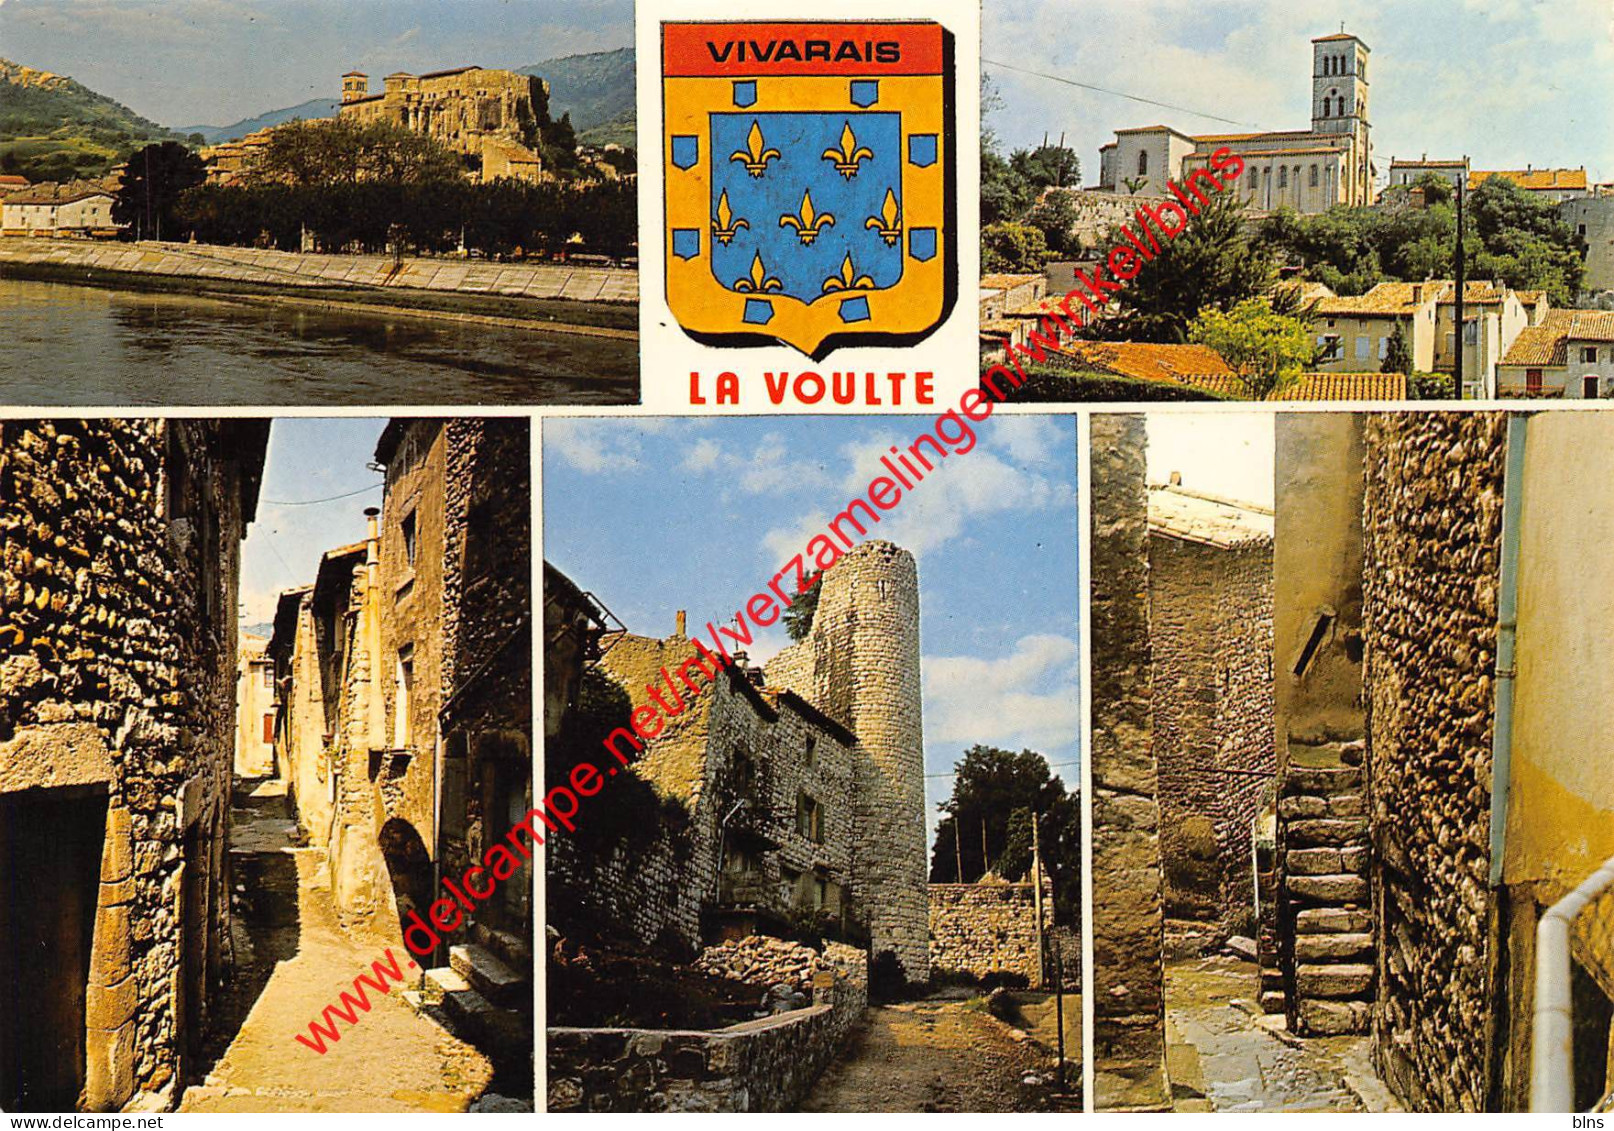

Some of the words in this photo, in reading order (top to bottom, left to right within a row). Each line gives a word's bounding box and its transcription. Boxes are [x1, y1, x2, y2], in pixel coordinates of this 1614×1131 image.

[706, 40, 901, 63] VIVARAIS
[689, 371, 739, 405] LA
[763, 371, 934, 405] VOULTE
